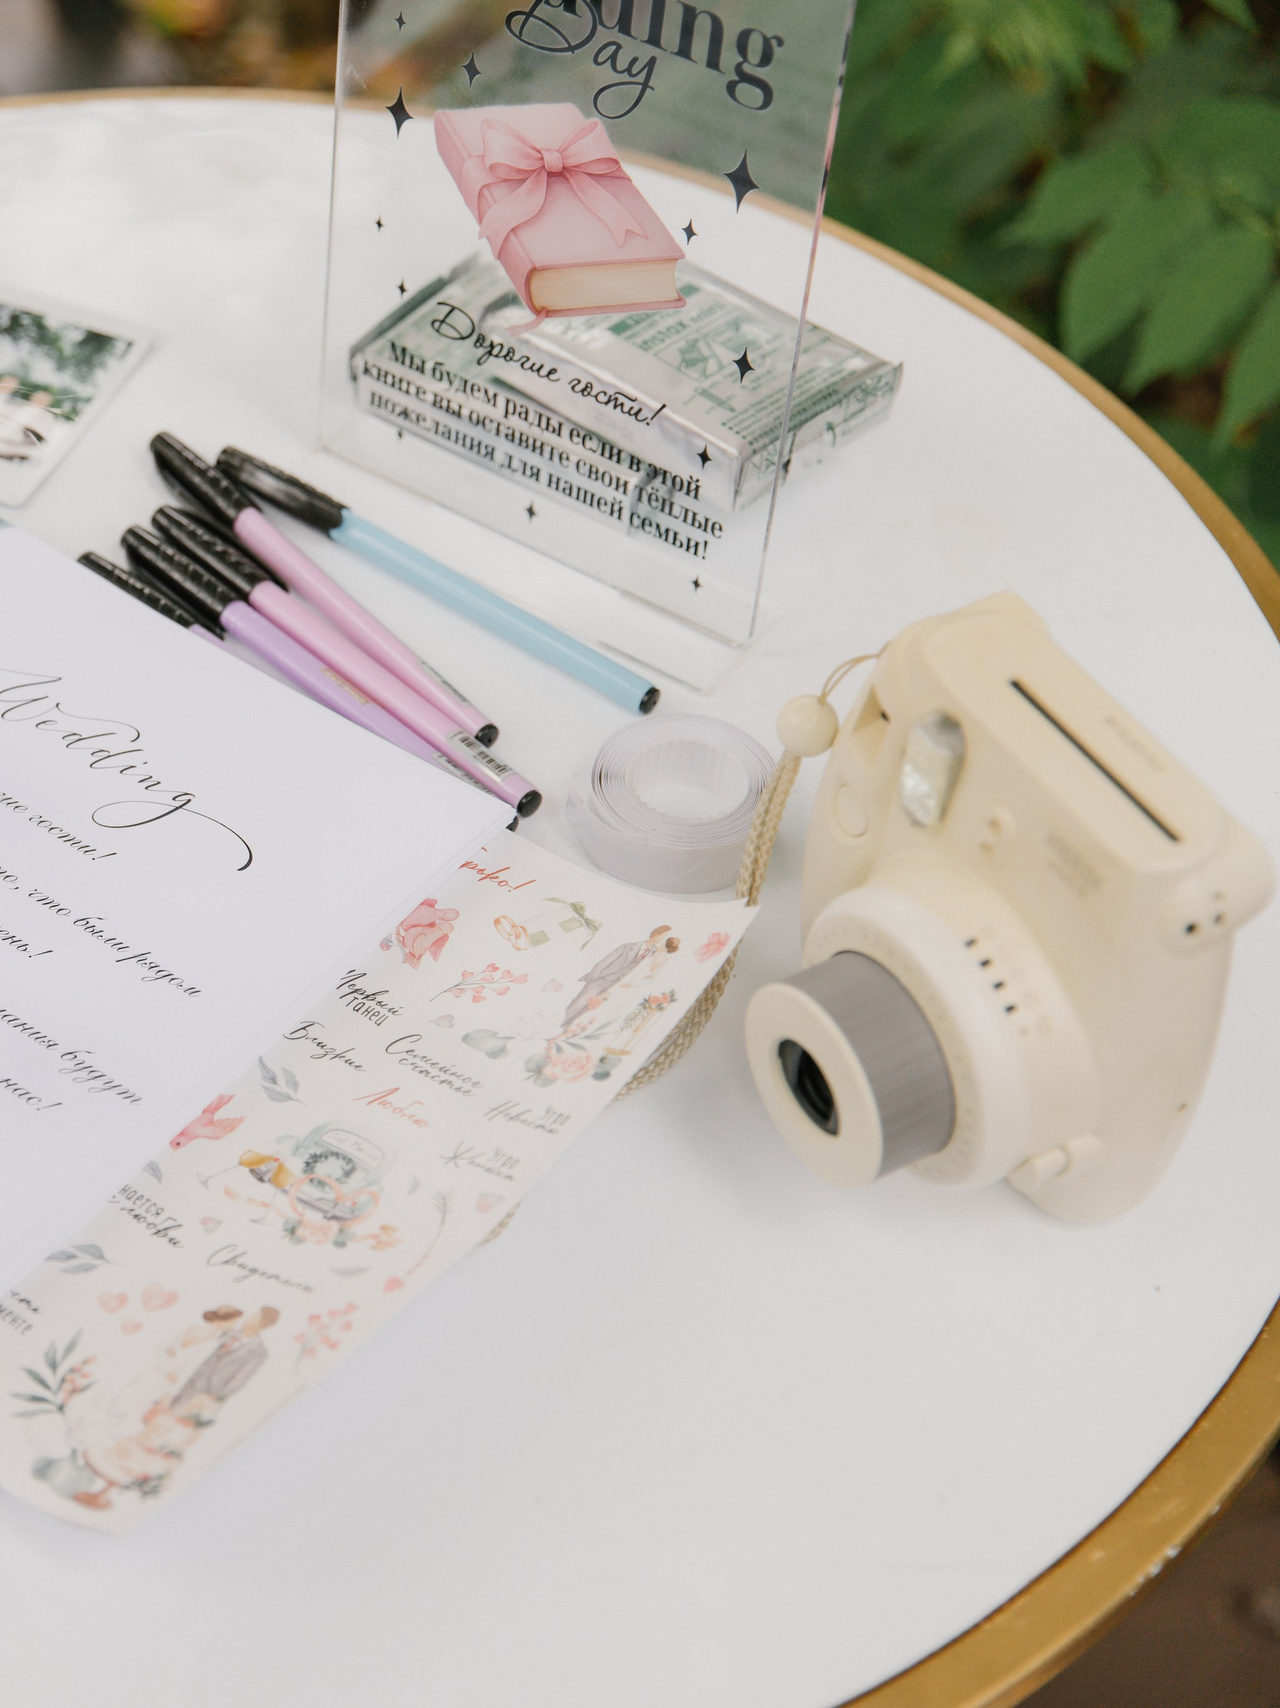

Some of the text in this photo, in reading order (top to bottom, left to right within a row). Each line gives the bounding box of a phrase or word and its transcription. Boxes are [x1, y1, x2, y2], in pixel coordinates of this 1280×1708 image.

[388, 341, 702, 501] Мы будем рады если в этой
[431, 301, 561, 382] Дорогие
[568, 377, 666, 426] гости!
[362, 359, 724, 539] книге вы оставите свои тёплые
[370, 391, 710, 560] пожелания для нашей семьи!
[28, 814, 117, 860] гости!
[28, 888, 71, 916] что
[73, 916, 130, 952] были
[115, 951, 201, 997] рядом
[59, 1050, 143, 1105] будут
